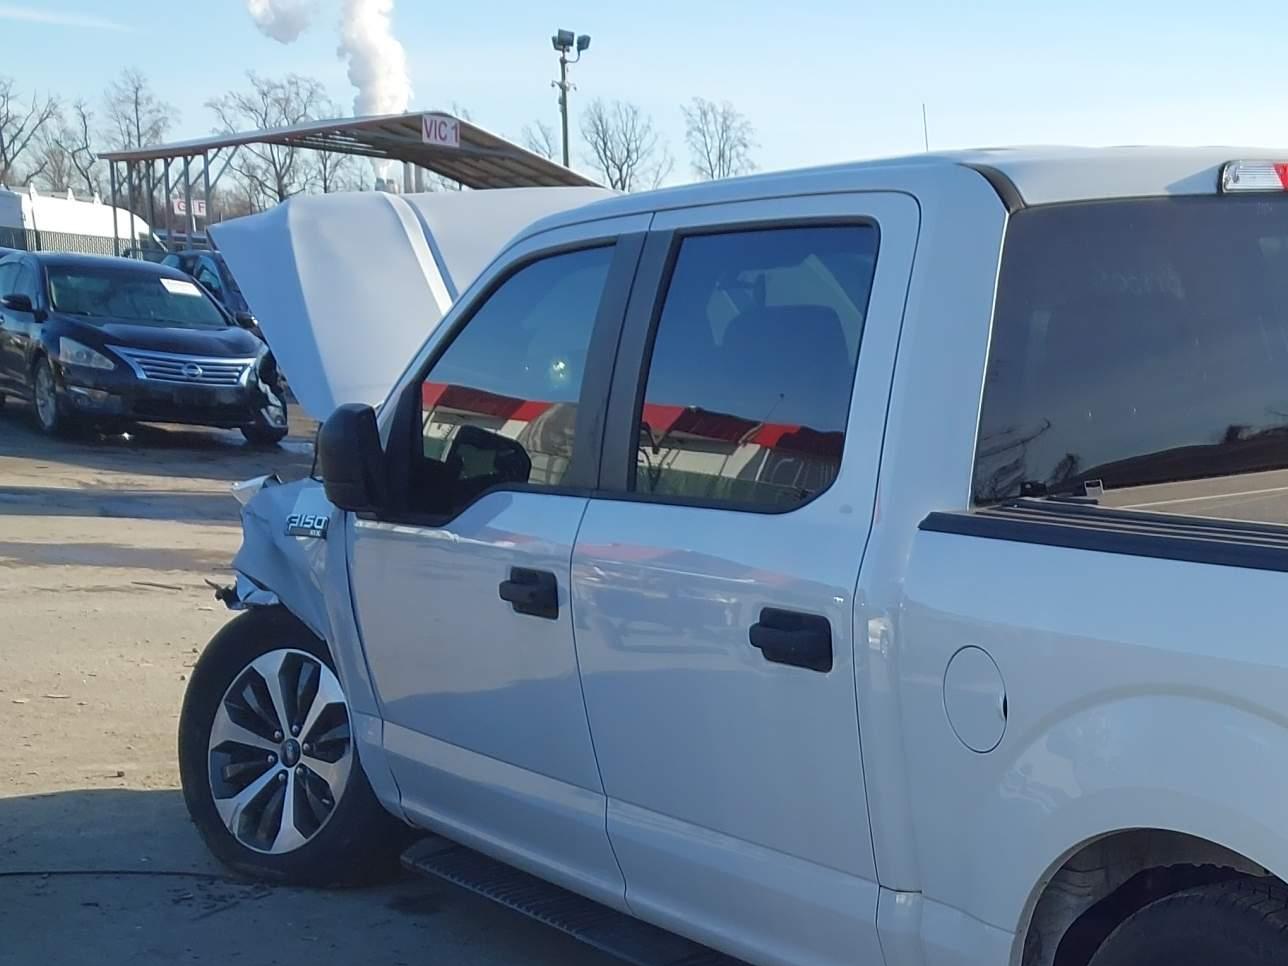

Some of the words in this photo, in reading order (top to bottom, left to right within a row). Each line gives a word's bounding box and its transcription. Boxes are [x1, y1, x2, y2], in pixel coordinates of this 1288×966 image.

[423, 117, 448, 141] VIC
[451, 122, 458, 144] 1
[198, 201, 206, 214] F
